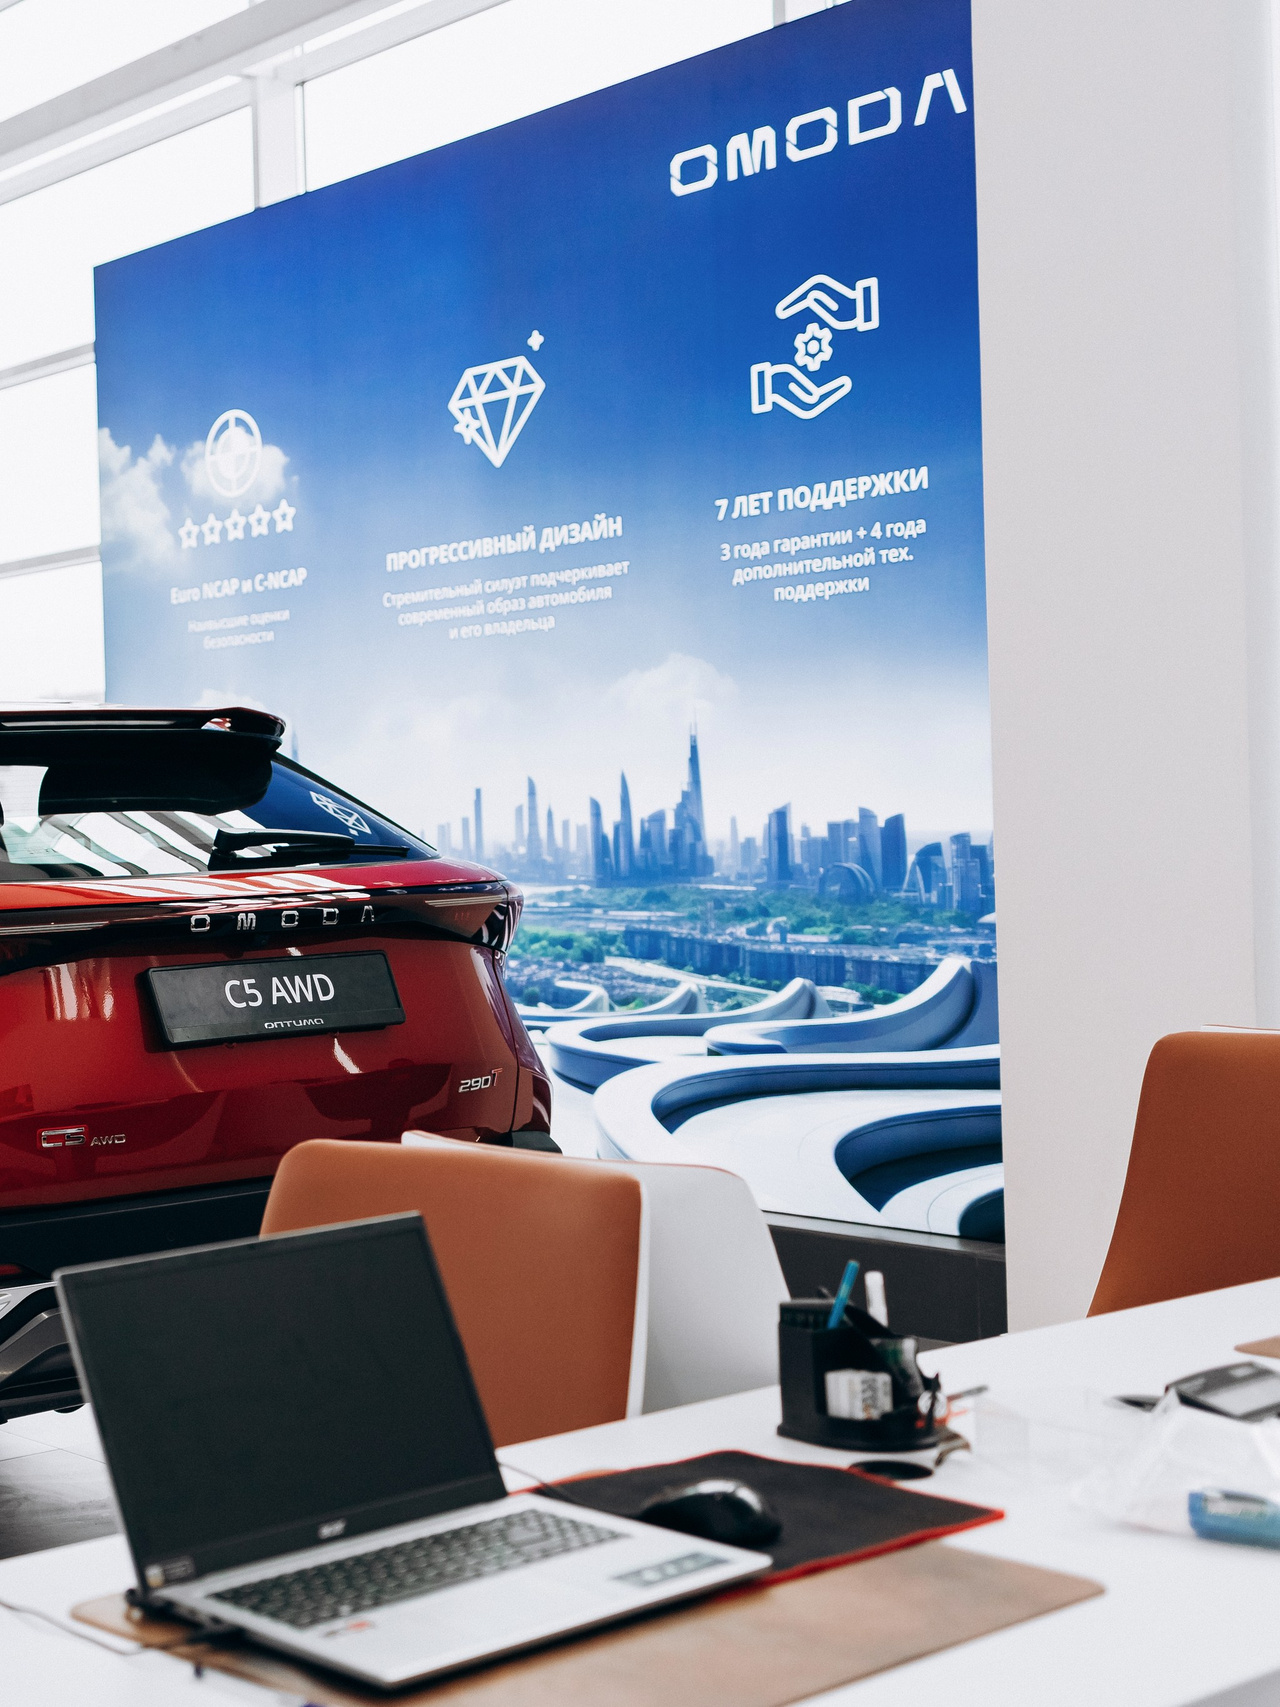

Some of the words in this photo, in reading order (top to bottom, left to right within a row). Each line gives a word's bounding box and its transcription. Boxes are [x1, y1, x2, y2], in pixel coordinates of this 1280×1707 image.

[670, 69, 967, 197] OMODA
[714, 498, 729, 521] 7
[731, 491, 773, 519] ЛЕТ
[777, 466, 929, 512] ПОДДЕРЖКИ
[385, 525, 536, 572] ПРОГРЕССИВНЫЙ
[538, 512, 623, 554] ДИЗАЙН
[720, 543, 731, 561] 3
[733, 541, 770, 560] года
[773, 529, 852, 555] гарантии
[870, 521, 882, 539] 4
[885, 518, 926, 539] года
[382, 578, 482, 609] Стремительный
[484, 574, 528, 594] силуэт
[530, 561, 630, 588] подчеркивает
[732, 547, 875, 586] дополнительной
[879, 546, 914, 564] тех.
[170, 586, 201, 604] Euro
[202, 577, 240, 600] NCAP
[241, 578, 252, 594] и
[254, 567, 308, 592] C-NCAP
[774, 577, 869, 603] поддержки
[398, 600, 484, 627] современный
[486, 597, 526, 616] образ
[527, 585, 612, 609] автомобиля
[449, 626, 458, 639] и
[460, 625, 482, 639] его
[484, 615, 555, 636] владельца
[190, 905, 375, 933] OMODA
[224, 978, 263, 1008] C5
[271, 973, 335, 1004] AWD
[458, 1067, 503, 1093] 290T
[41, 1126, 86, 1148] C5
[90, 1133, 126, 1147] AWD
